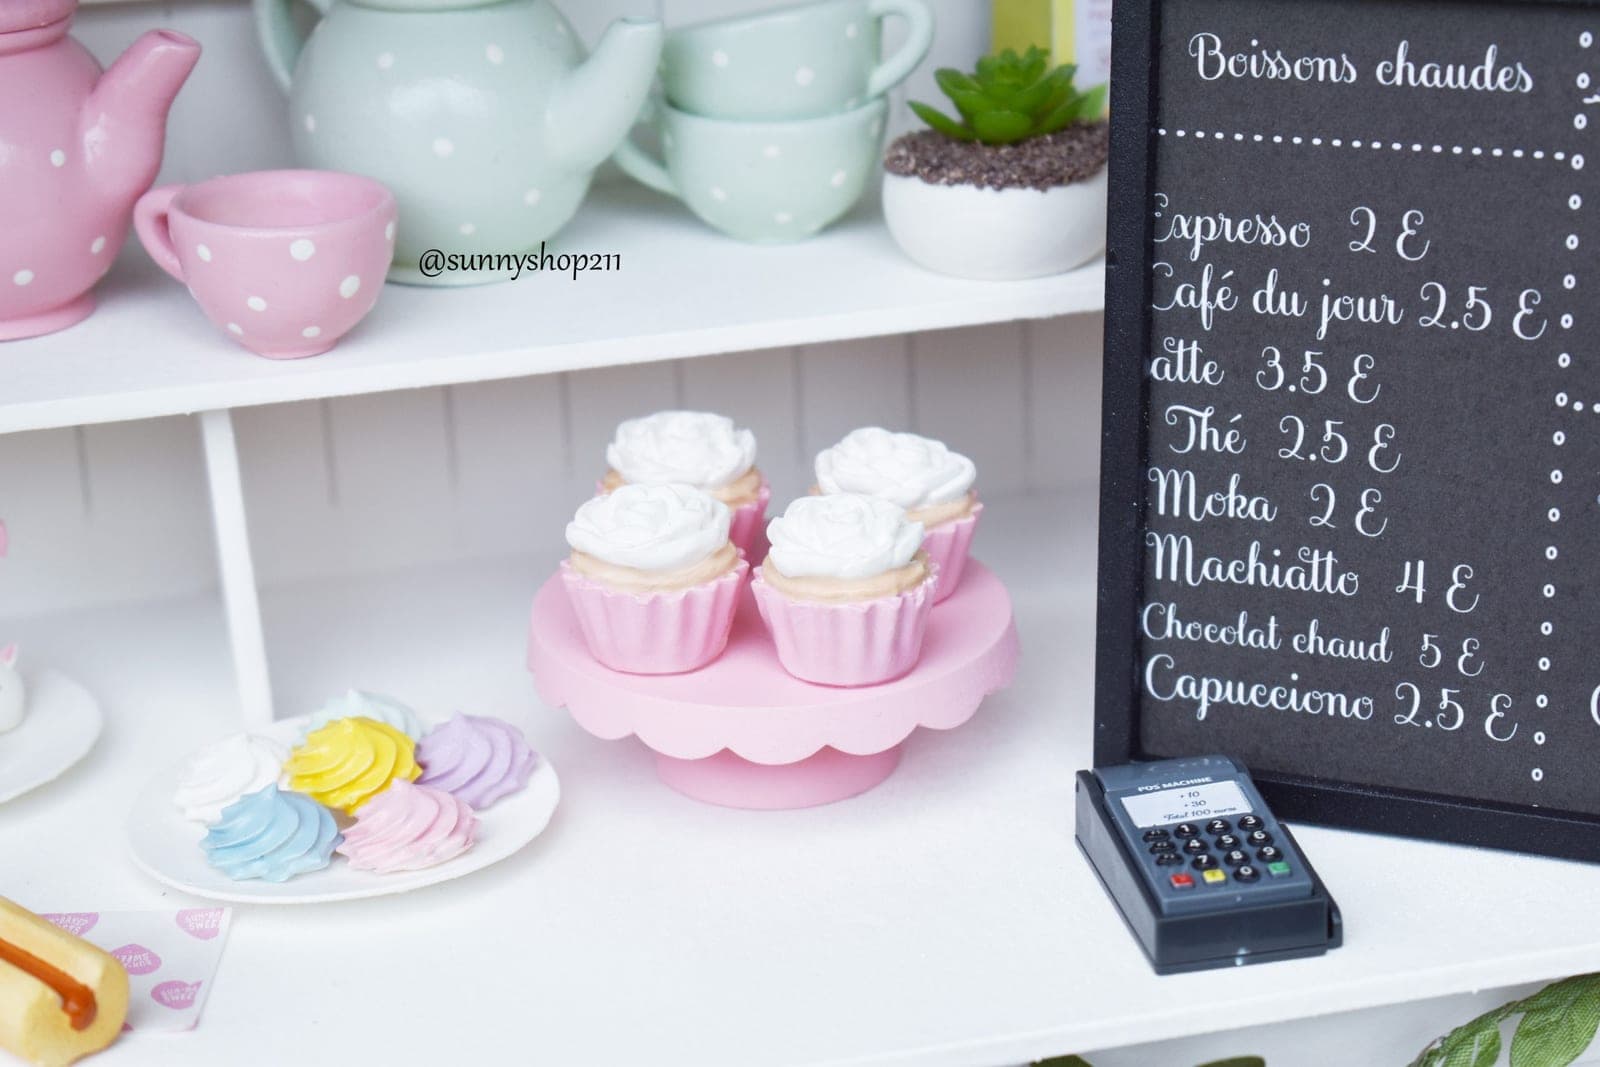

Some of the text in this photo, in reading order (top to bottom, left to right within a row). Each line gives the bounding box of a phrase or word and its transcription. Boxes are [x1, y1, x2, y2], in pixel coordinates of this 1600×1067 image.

[1188, 32, 1534, 94] Boissons chaudes
[1348, 205, 1377, 254] 2
[1252, 267, 1308, 318] du
[1315, 277, 1405, 341] jour
[1418, 281, 1493, 332] 2.5
[1255, 345, 1328, 395] 3.5
[1164, 404, 1247, 455] Thé
[1277, 414, 1349, 464] 2.5
[1147, 466, 1278, 523] Moka
[1308, 482, 1337, 529] 2
[1146, 528, 1360, 597] Machiatto
[1395, 559, 1427, 604] 4
[1142, 601, 1283, 651] Chocolat
[1292, 618, 1394, 664] chaud
[1418, 633, 1442, 669] 5
[1145, 652, 1375, 722] Capucciono
[1393, 681, 1465, 731] 2.5
[1138, 776, 1213, 793] POS MACHINE
[1213, 820, 1224, 829] 2
[1245, 816, 1255, 824] 3
[1221, 835, 1233, 844] 5
[1254, 831, 1265, 840] 6
[1198, 846, 1274, 864] 7 8 9
